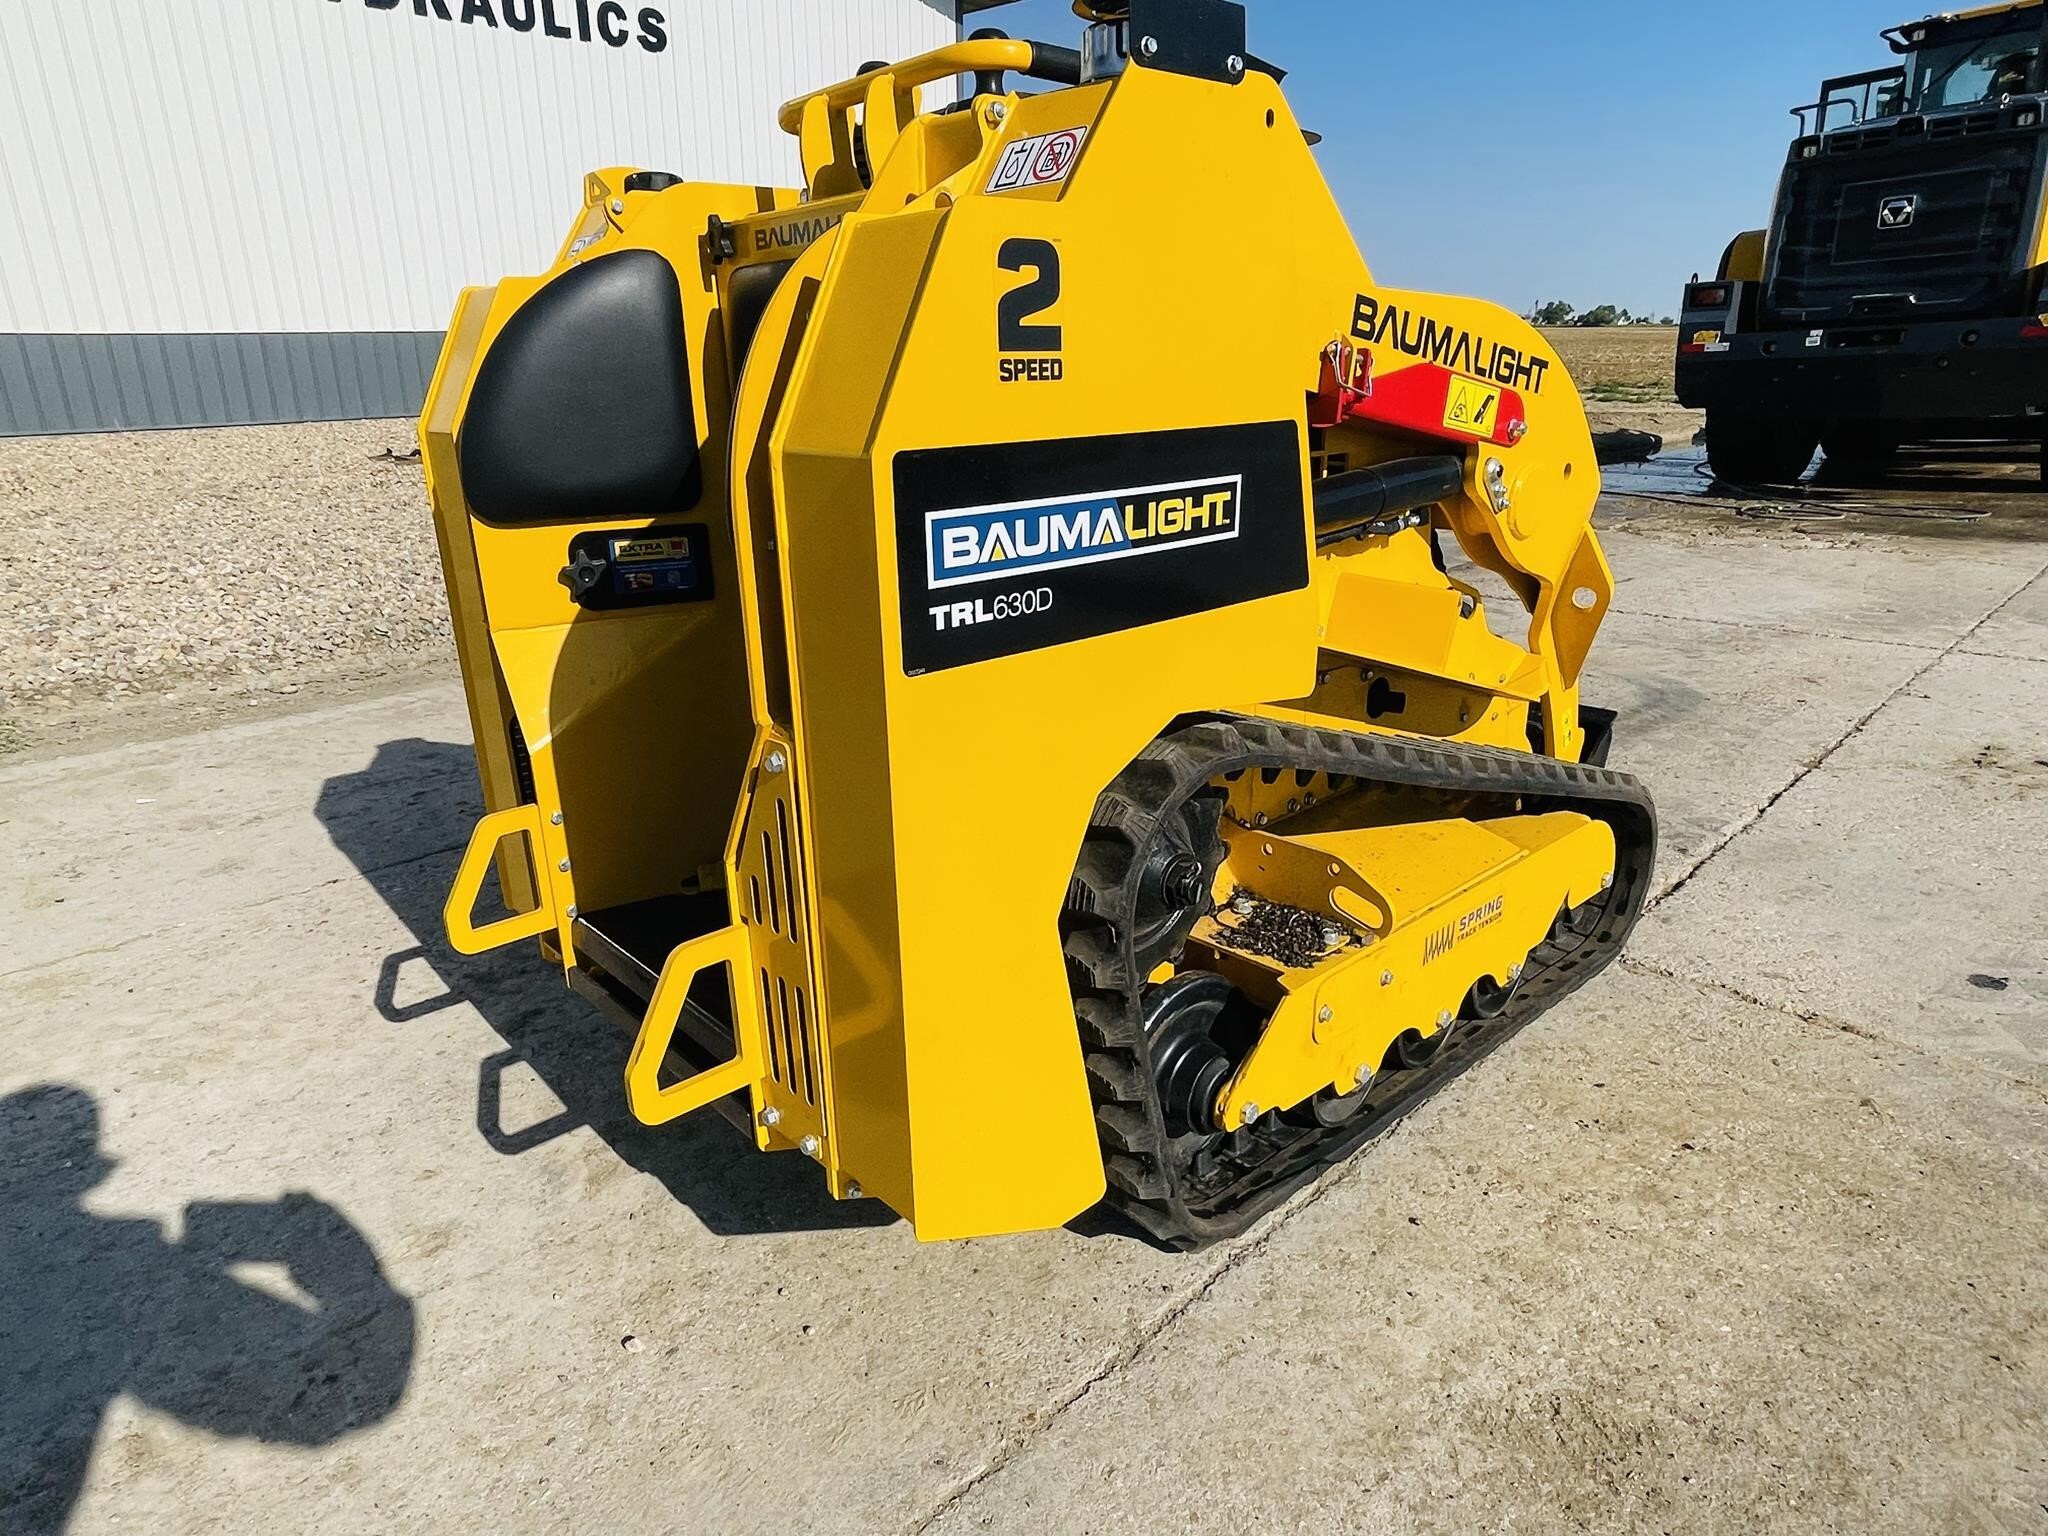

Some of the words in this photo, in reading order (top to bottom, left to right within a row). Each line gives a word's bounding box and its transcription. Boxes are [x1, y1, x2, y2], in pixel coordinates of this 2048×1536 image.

[755, 214, 841, 251] BAUMA
[997, 238, 1062, 352] 2
[1350, 293, 1549, 393] BAUMALIGHT
[1000, 358, 1063, 382] SPEED
[619, 542, 664, 553] EXTRA
[942, 490, 1232, 569] BAUMALIGHT
[929, 587, 1053, 631] TRL630D
[1459, 895, 1503, 932] SPRING
[1457, 926, 1478, 942] TRACK
